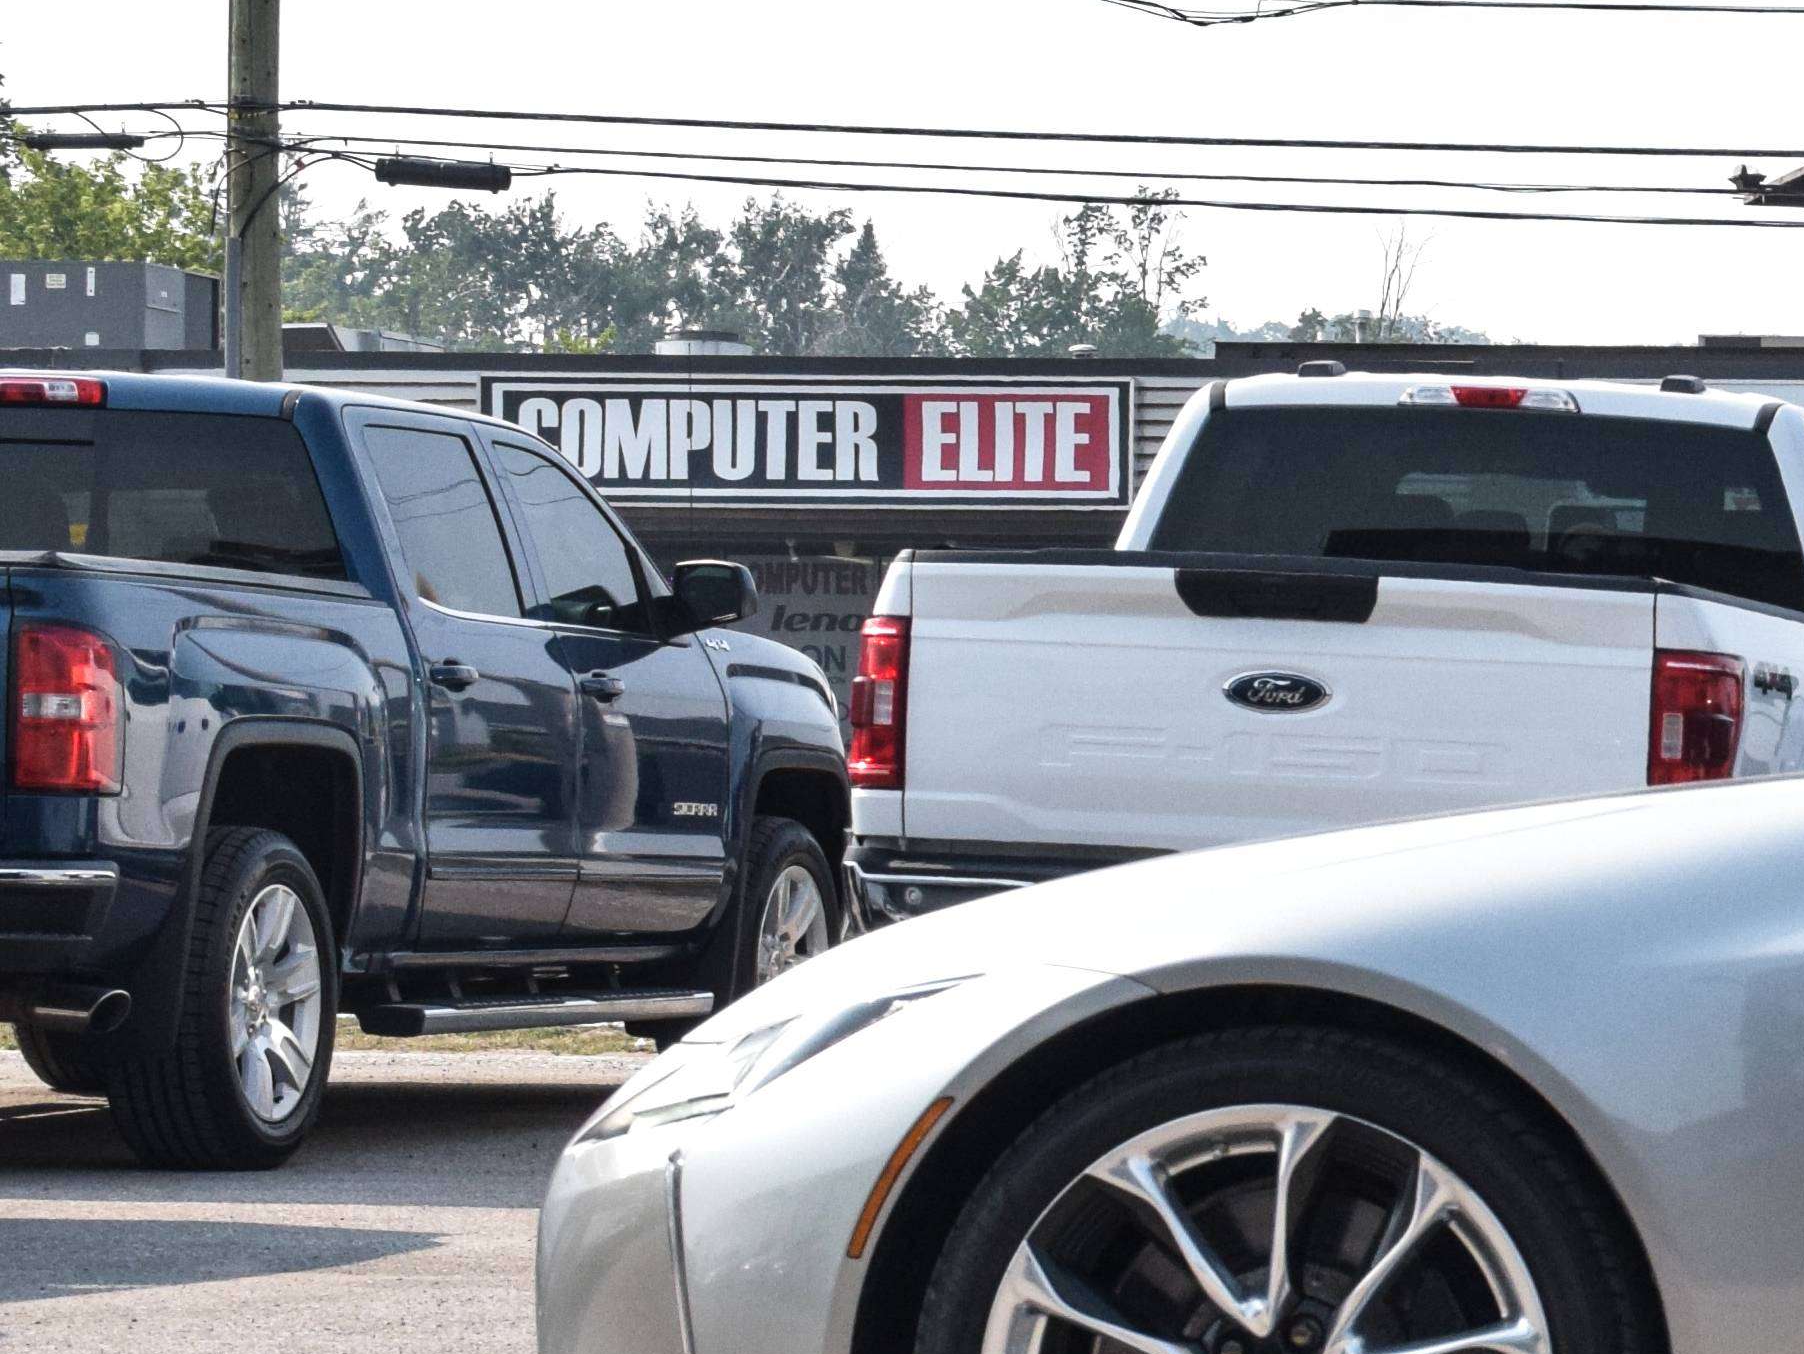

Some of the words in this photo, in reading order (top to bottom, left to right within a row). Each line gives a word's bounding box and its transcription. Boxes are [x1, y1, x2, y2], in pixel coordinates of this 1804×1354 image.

[518, 397, 879, 481] COMPUTER
[921, 401, 1091, 483] ELITE
[751, 561, 868, 595] OMPUTER
[772, 604, 865, 632] leno
[1247, 677, 1306, 703] Ford
[673, 802, 718, 816] SIERRA
